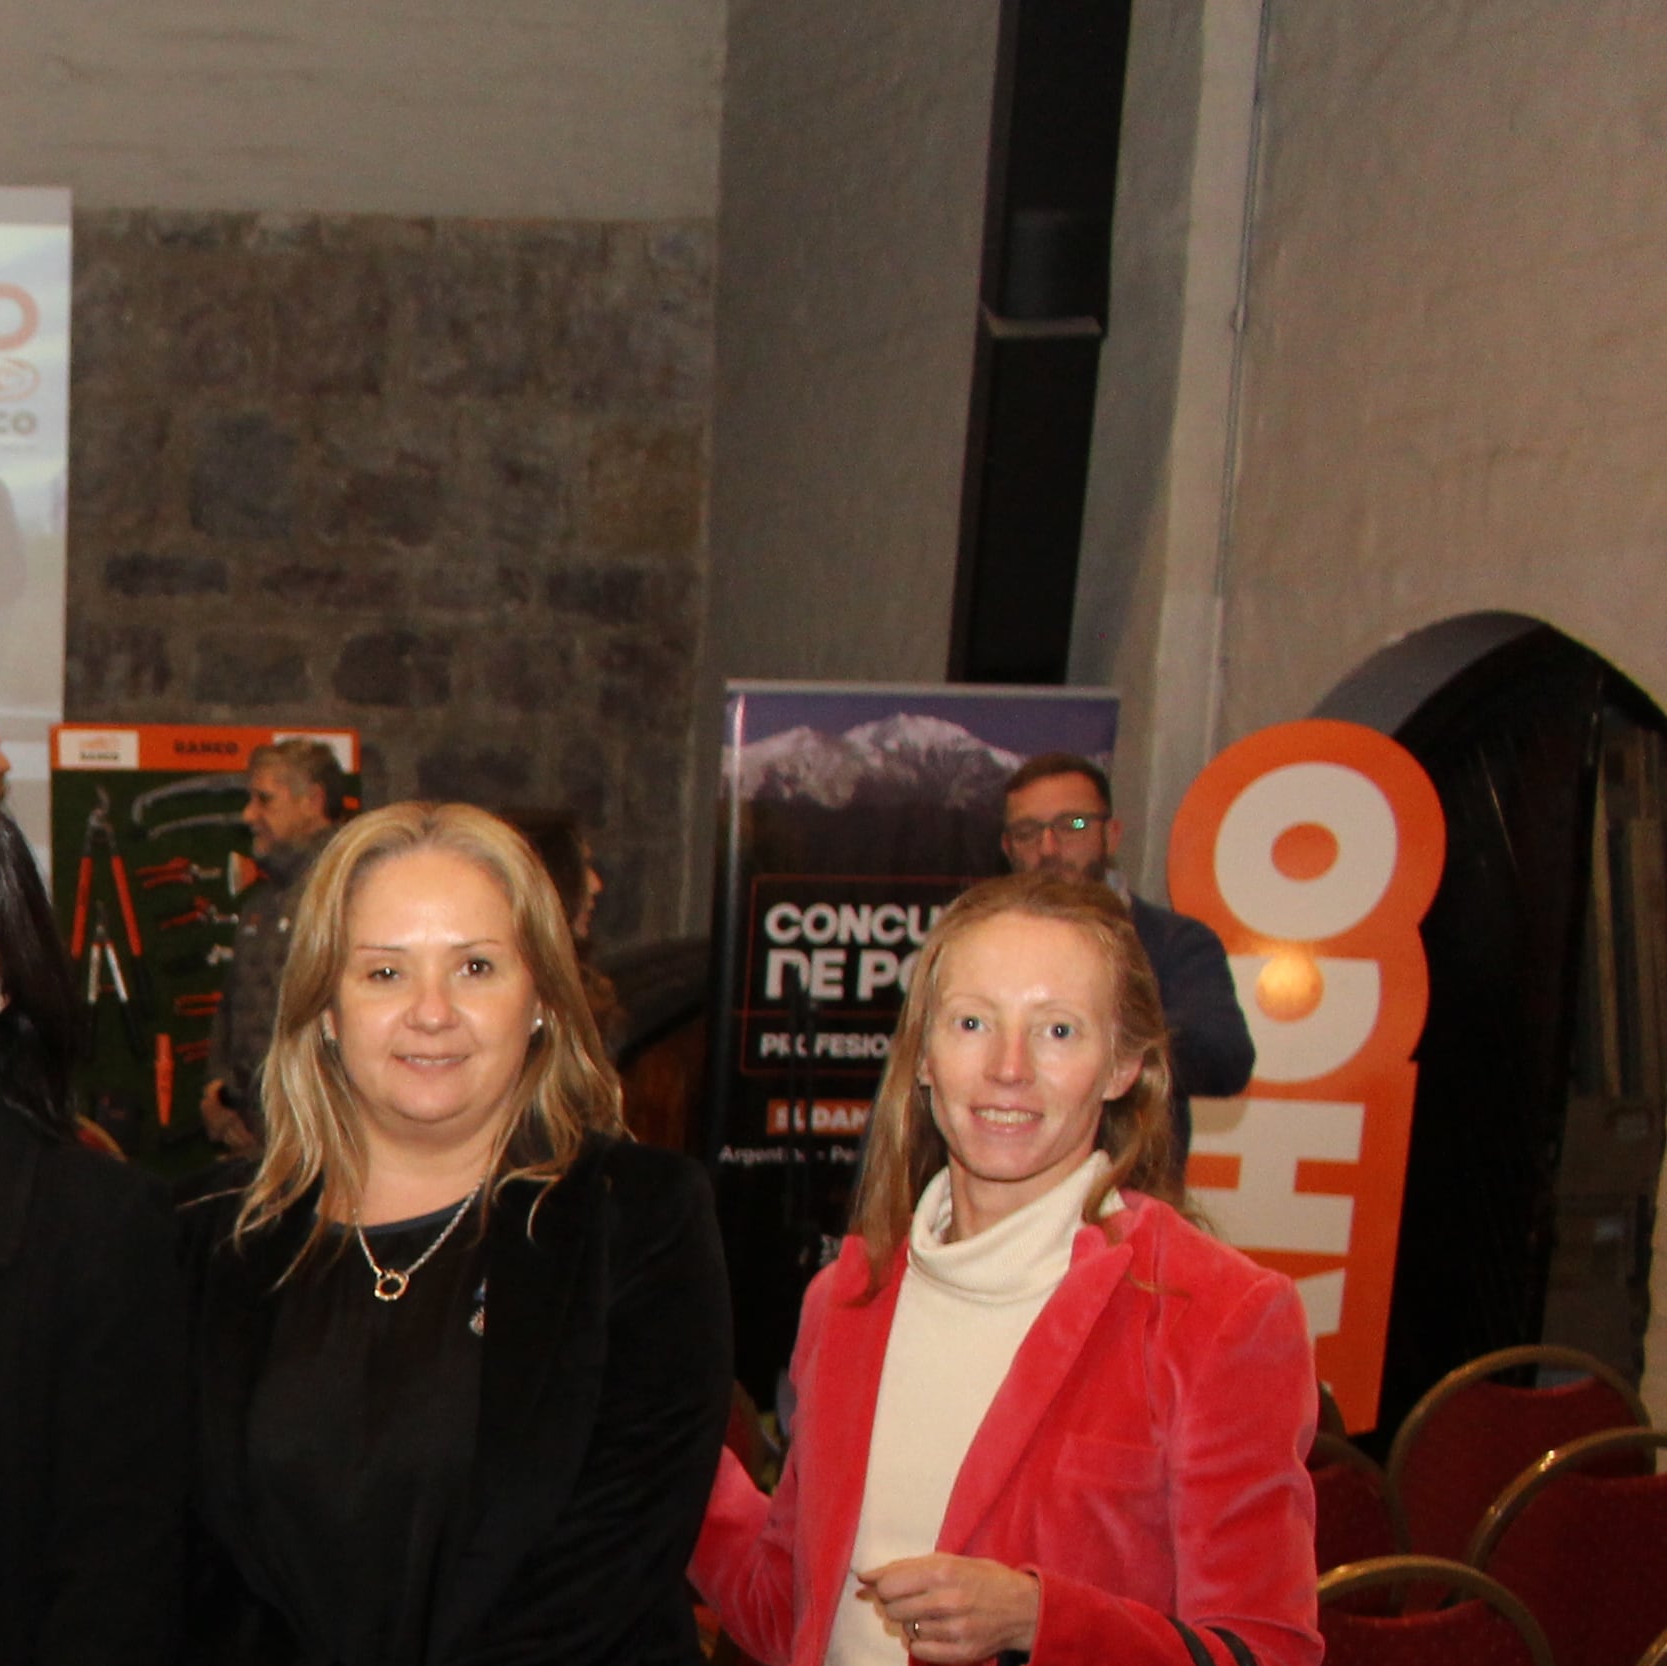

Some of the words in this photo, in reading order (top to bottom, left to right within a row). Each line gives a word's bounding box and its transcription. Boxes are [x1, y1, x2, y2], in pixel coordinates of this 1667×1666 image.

[765, 902, 943, 945] CONCU
[766, 949, 848, 1000] DE
[759, 1033, 891, 1057] PROFESIO
[1187, 761, 1398, 1336] HCO
